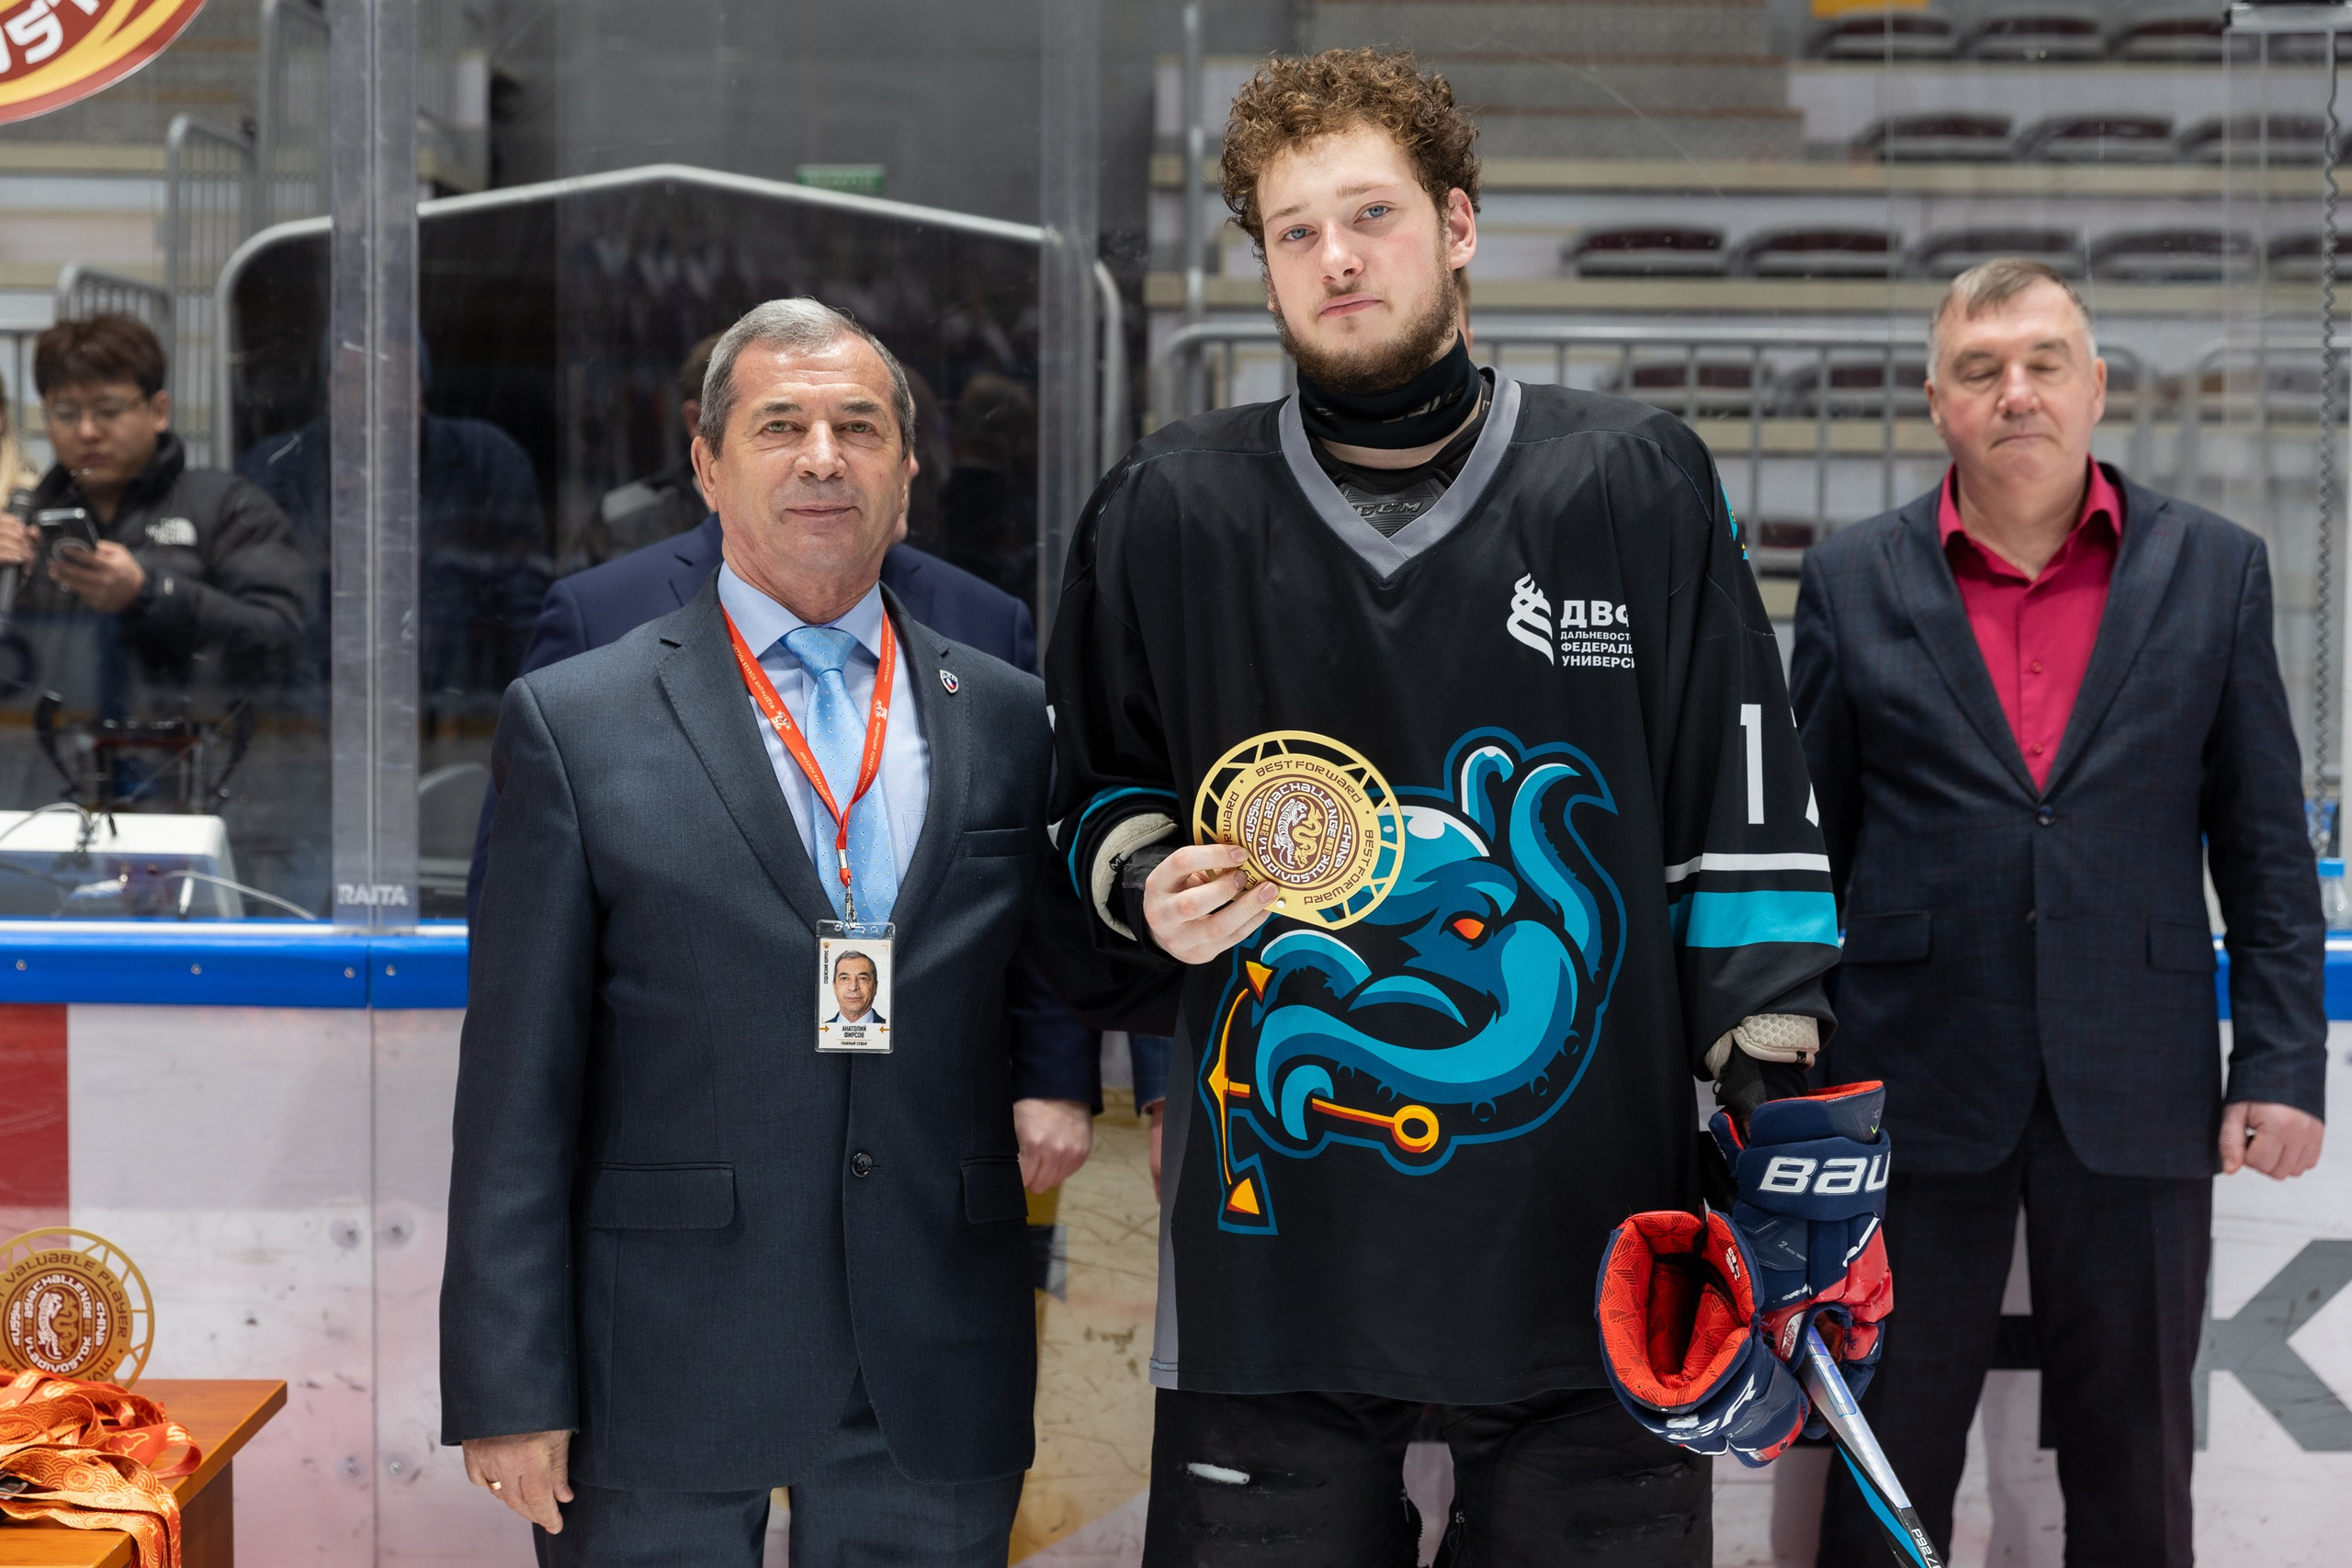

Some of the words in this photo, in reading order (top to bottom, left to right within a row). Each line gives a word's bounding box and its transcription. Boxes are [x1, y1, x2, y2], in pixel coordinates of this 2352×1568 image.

[1357, 502, 1423, 515] CCM
[1561, 631, 1632, 641] ДАЛЬНЕВОСТ
[1255, 761, 1293, 777] BEST
[1362, 829, 1374, 866] BEST
[1911, 1529, 1941, 1568] P92/
